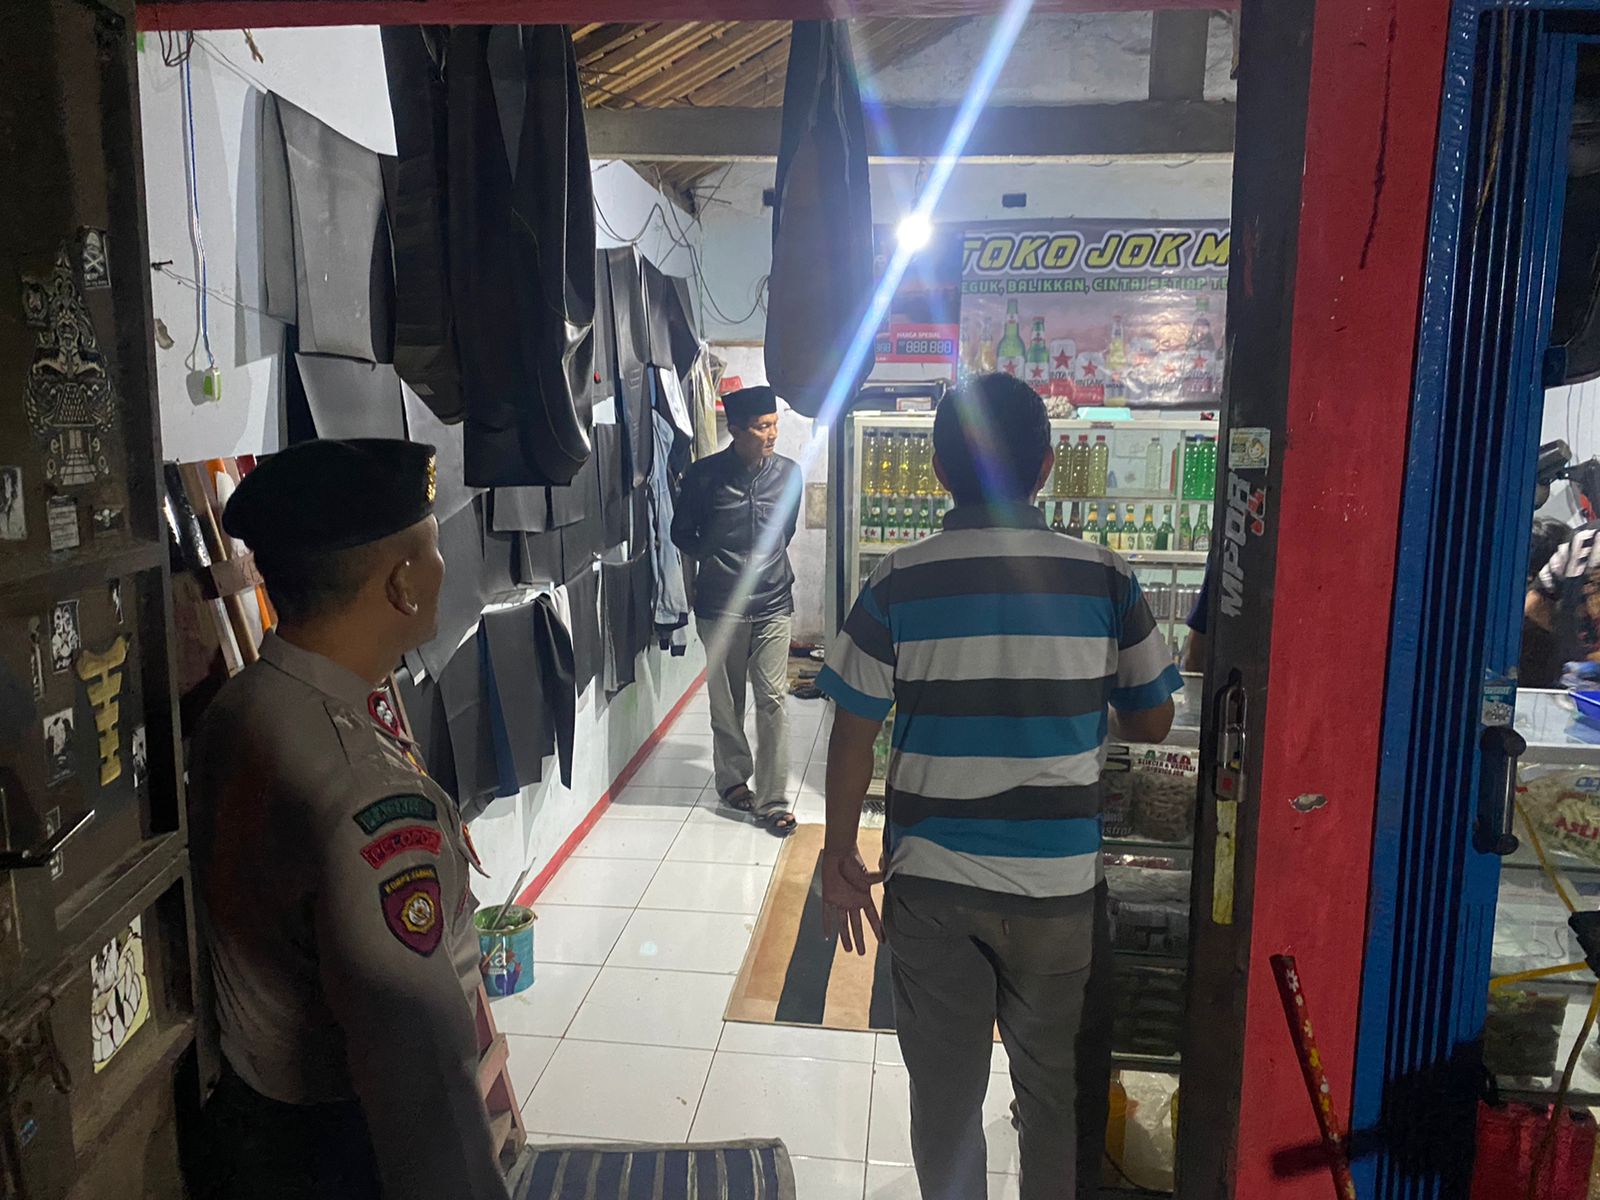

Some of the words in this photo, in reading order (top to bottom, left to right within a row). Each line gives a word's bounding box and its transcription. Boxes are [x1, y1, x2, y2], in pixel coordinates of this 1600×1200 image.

[963, 235, 1081, 271] TOKO
[1085, 233, 1191, 268] JOK
[1007, 278, 1090, 295] BALIKKAN,
[1093, 276, 1146, 291] CINTAI
[1144, 749, 1191, 765] AZKA
